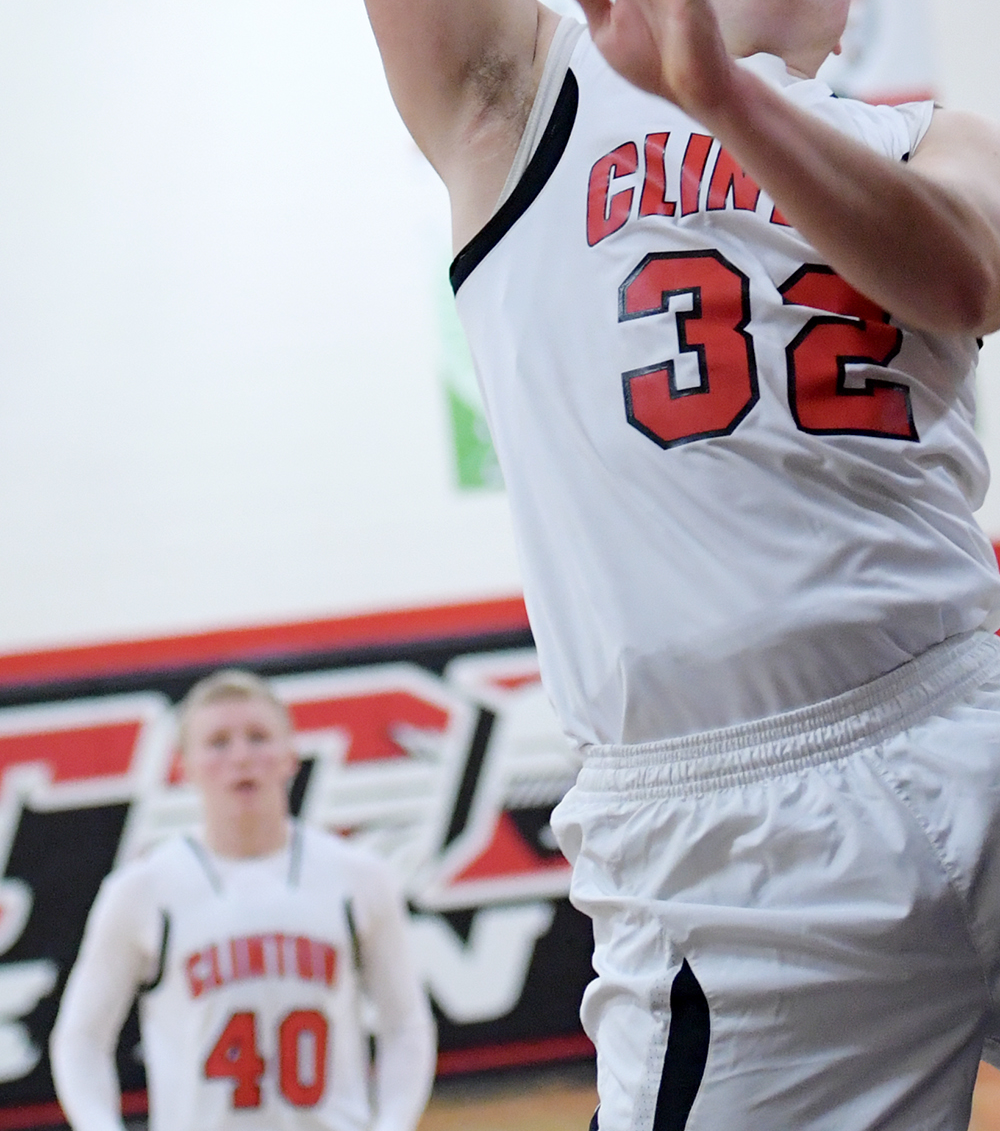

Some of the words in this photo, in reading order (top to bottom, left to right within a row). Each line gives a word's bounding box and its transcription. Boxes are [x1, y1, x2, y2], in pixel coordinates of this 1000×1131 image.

[586, 131, 792, 248] CLIN
[617, 248, 921, 450] 32
[204, 1008, 330, 1108] 40
